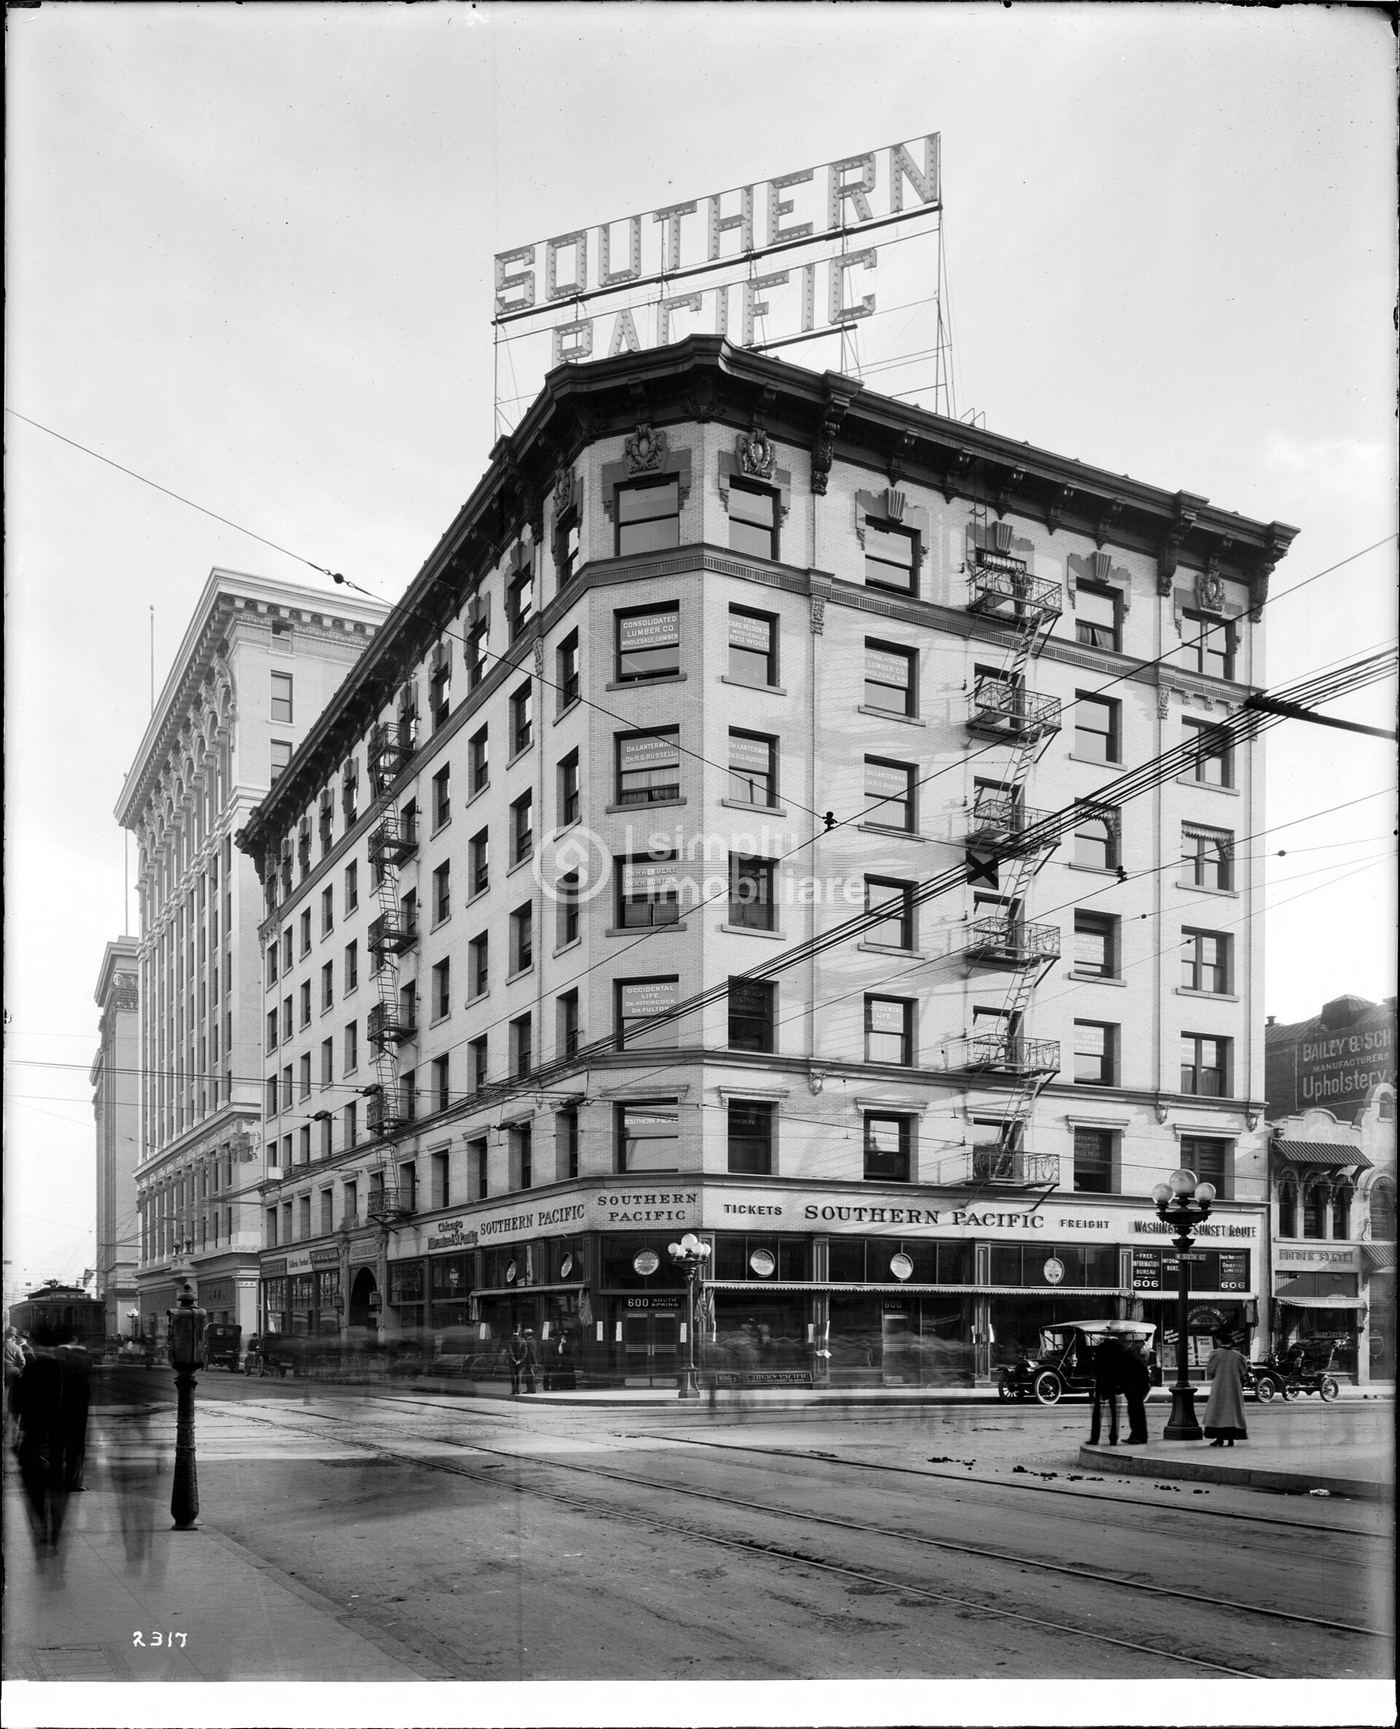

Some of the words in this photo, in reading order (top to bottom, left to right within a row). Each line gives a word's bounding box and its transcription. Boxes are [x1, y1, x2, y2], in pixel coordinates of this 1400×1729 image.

[494, 132, 940, 316] SOUTHERN
[552, 247, 877, 366] PACIFIC
[623, 615, 677, 629] CONSOLIDATED
[627, 626, 661, 638] LUMBER
[662, 624, 674, 633] CO
[746, 638, 769, 649] WOOD
[626, 985, 675, 994] OCCIDENTAL
[1303, 1037, 1348, 1062] BAILEY
[1349, 1036, 1361, 1053] &
[1313, 1052, 1391, 1073] MANUFACTURERS
[1303, 1069, 1387, 1103] Upholstery
[597, 1193, 698, 1206] SOUTHERN
[480, 1214, 533, 1236] SOUTHERN
[537, 1204, 585, 1226] PACIFIC
[608, 1210, 686, 1222] PACIFIC
[724, 1204, 783, 1216] TICKETS
[804, 1205, 940, 1225] SOUTHERN
[952, 1211, 1044, 1229] PACIFIC
[1060, 1219, 1110, 1229] FREIGHT
[438, 1220, 463, 1234] Chicago
[1134, 1220, 1180, 1235] WASHING
[1194, 1224, 1226, 1237] SUNSET
[1229, 1225, 1257, 1238] ROUTE
[1133, 1260, 1160, 1268] INFORMATION
[1133, 1280, 1159, 1288] 606
[1221, 1281, 1246, 1289] 606
[628, 1298, 649, 1307] 600
[884, 1300, 903, 1309] 600
